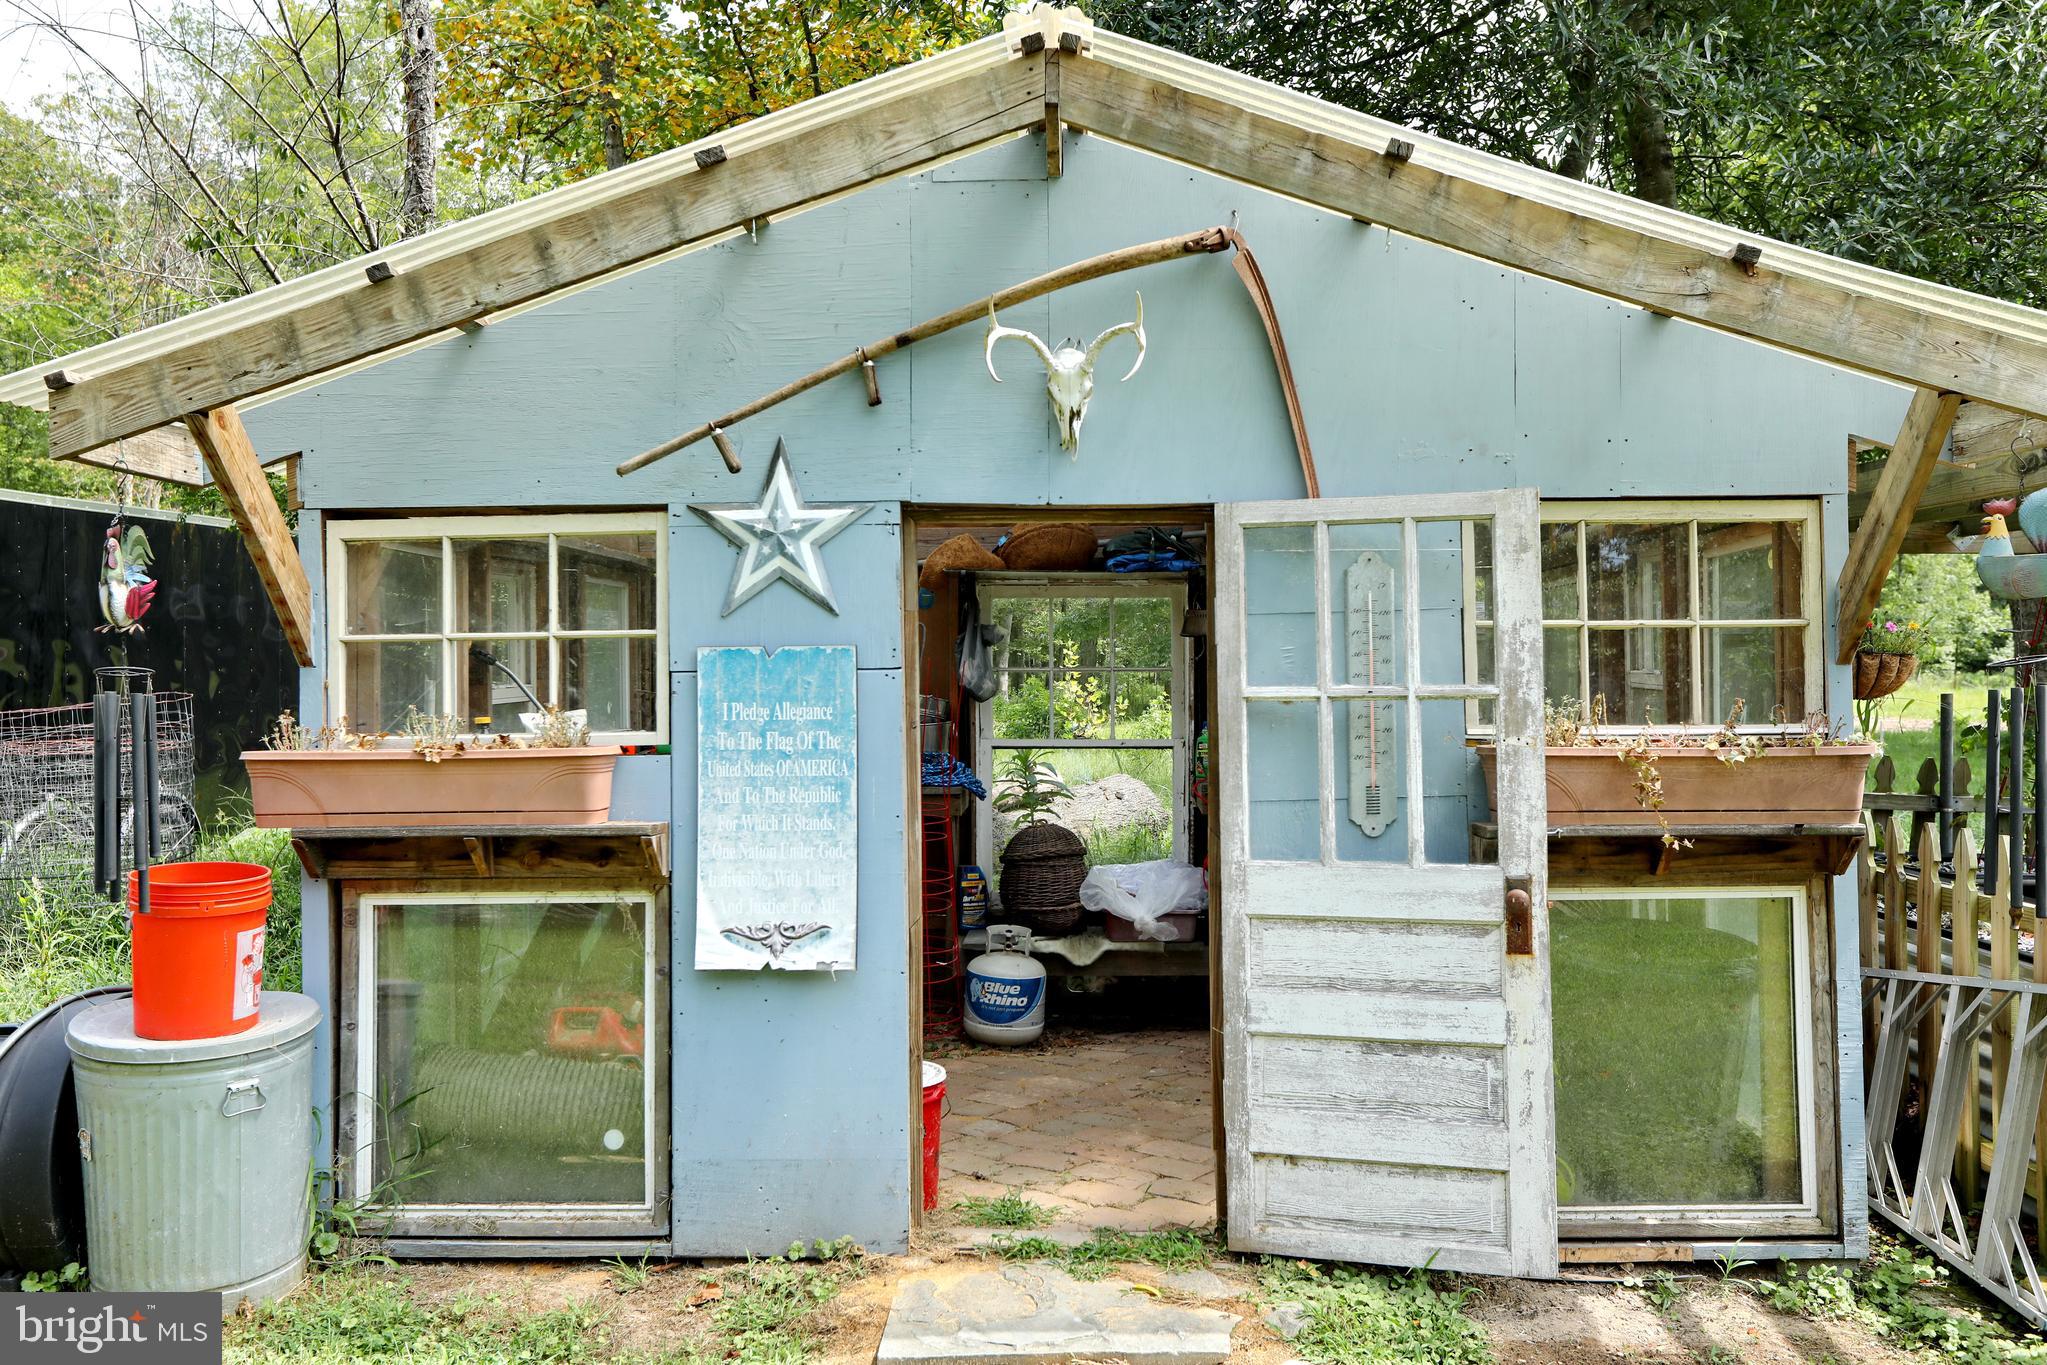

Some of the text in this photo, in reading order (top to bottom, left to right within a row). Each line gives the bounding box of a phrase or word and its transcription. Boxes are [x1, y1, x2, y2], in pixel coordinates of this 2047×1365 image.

[722, 700, 833, 726] I Pledge Allegiance
[717, 730, 842, 755] To The Flag Of The
[707, 759, 849, 778] United States Of AMERICA
[717, 785, 842, 807] And To The Republic
[718, 812, 836, 831] For Which It Stands.
[712, 842, 736, 860] One
[739, 842, 777, 860] Nation
[780, 842, 815, 860] Under
[774, 869, 802, 888] With
[720, 896, 744, 914] And
[792, 896, 814, 914] For
[984, 981, 1021, 994] Blue
[980, 993, 1028, 1007] Rhino
